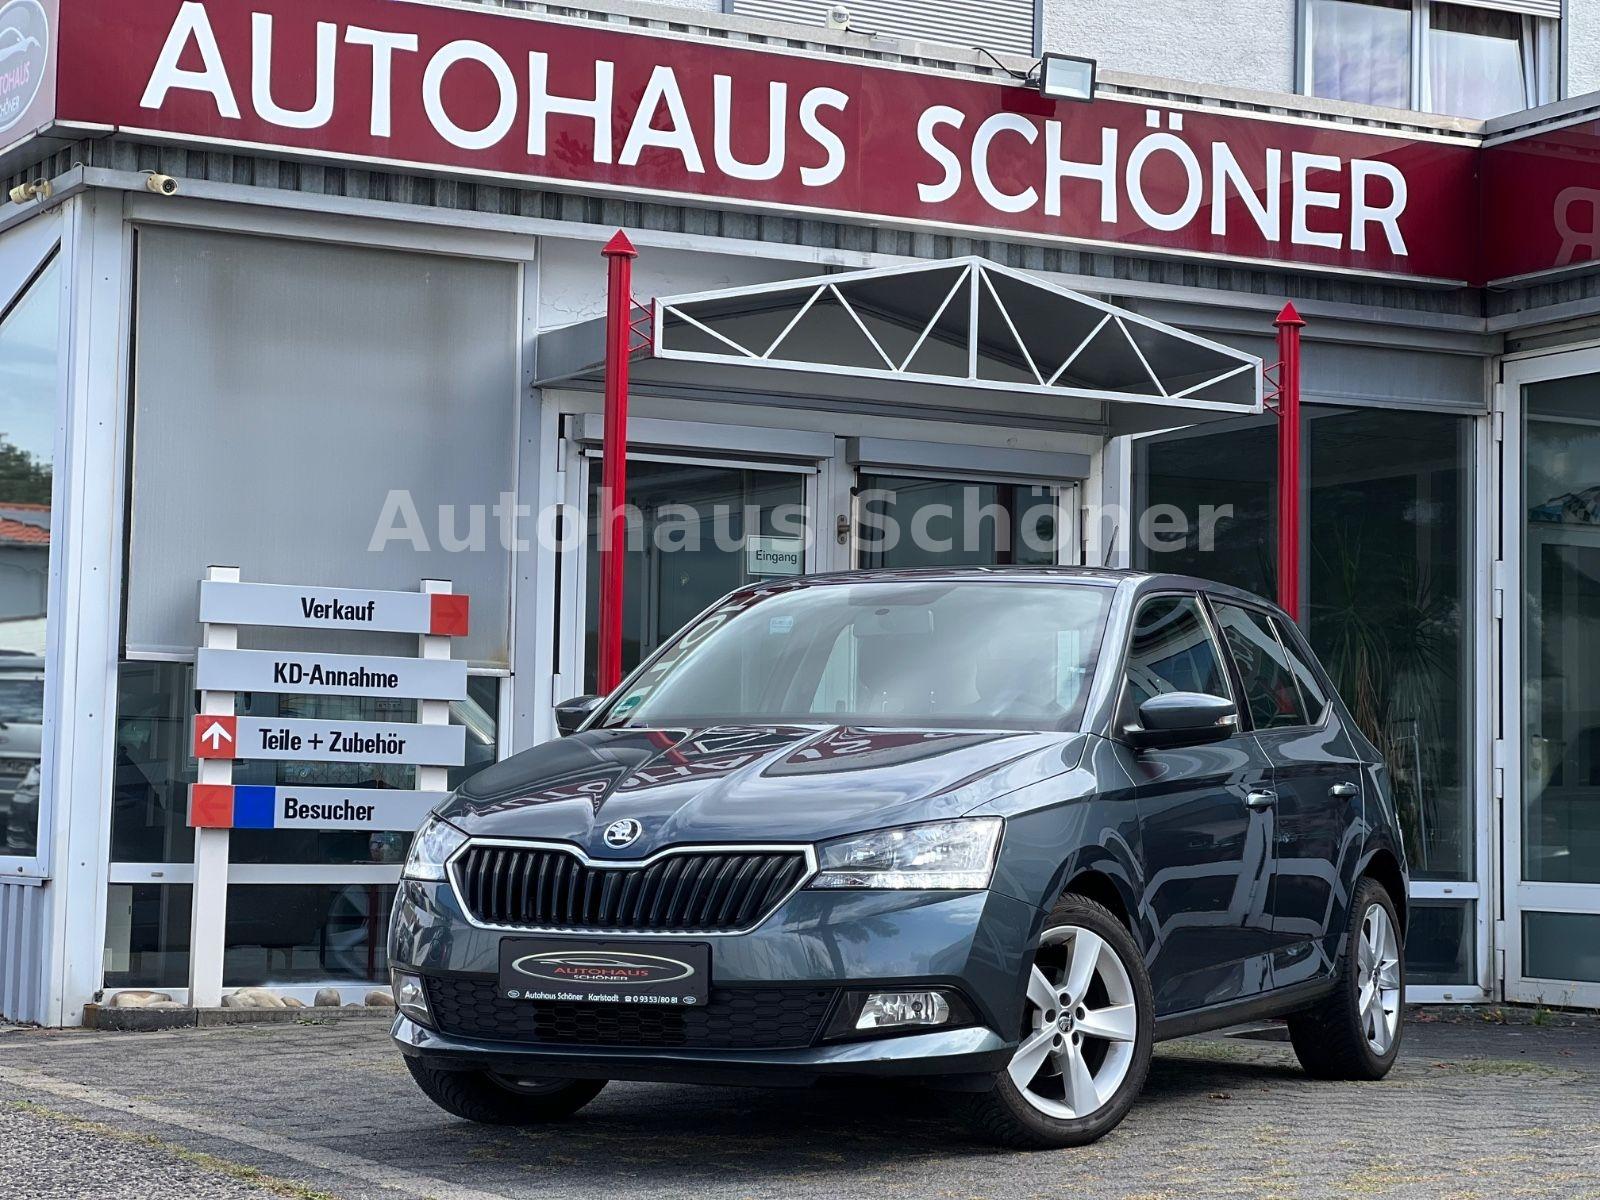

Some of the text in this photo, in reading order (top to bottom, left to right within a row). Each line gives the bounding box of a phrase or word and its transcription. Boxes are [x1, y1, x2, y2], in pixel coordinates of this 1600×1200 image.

[139, 1, 849, 187] AUTOHAUS
[917, 105, 1409, 257] SCHÖNER
[756, 549, 798, 565] Eingang
[301, 597, 375, 622] Verkauf
[273, 662, 399, 689] KD-Annahme
[258, 728, 302, 751] Teile
[329, 731, 406, 755] Zubehör
[283, 798, 375, 821] Besucher
[554, 967, 649, 977] AUTOHAUS
[524, 990, 556, 1000] Autohaus
[557, 991, 584, 1001] Schöner
[588, 993, 619, 1002] Karlstadt
